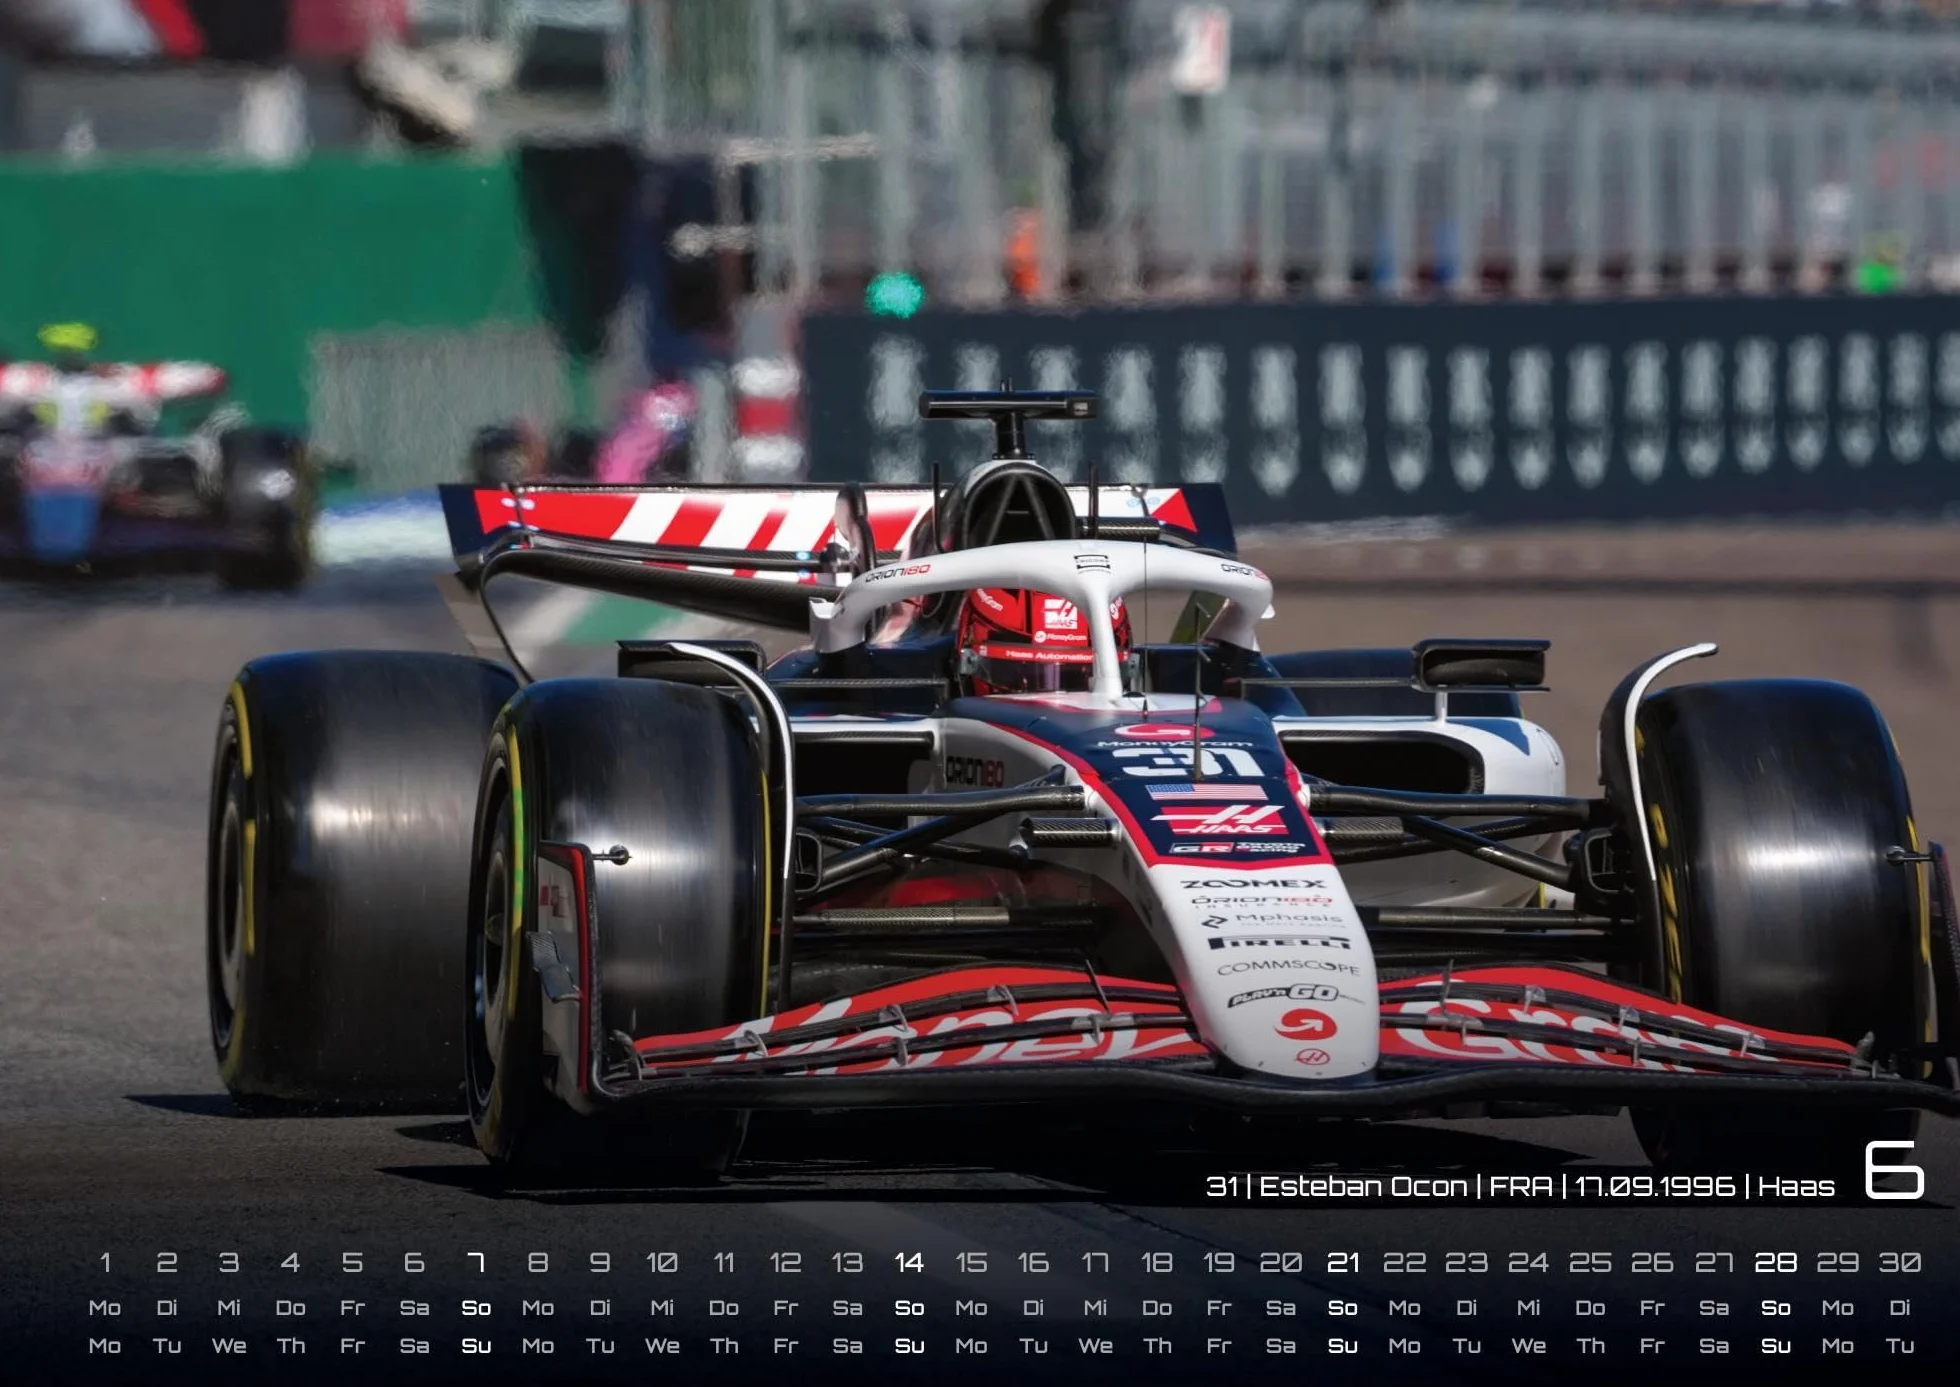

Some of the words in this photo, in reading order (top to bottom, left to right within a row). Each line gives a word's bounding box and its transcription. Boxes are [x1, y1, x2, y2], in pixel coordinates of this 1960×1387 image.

[1112, 748, 1265, 776] 31
[1181, 879, 1327, 889] ZOOMEX
[1236, 913, 1344, 923] Mphasis
[1217, 959, 1361, 976] COMMSCOPE
[1288, 983, 1339, 1001] GO
